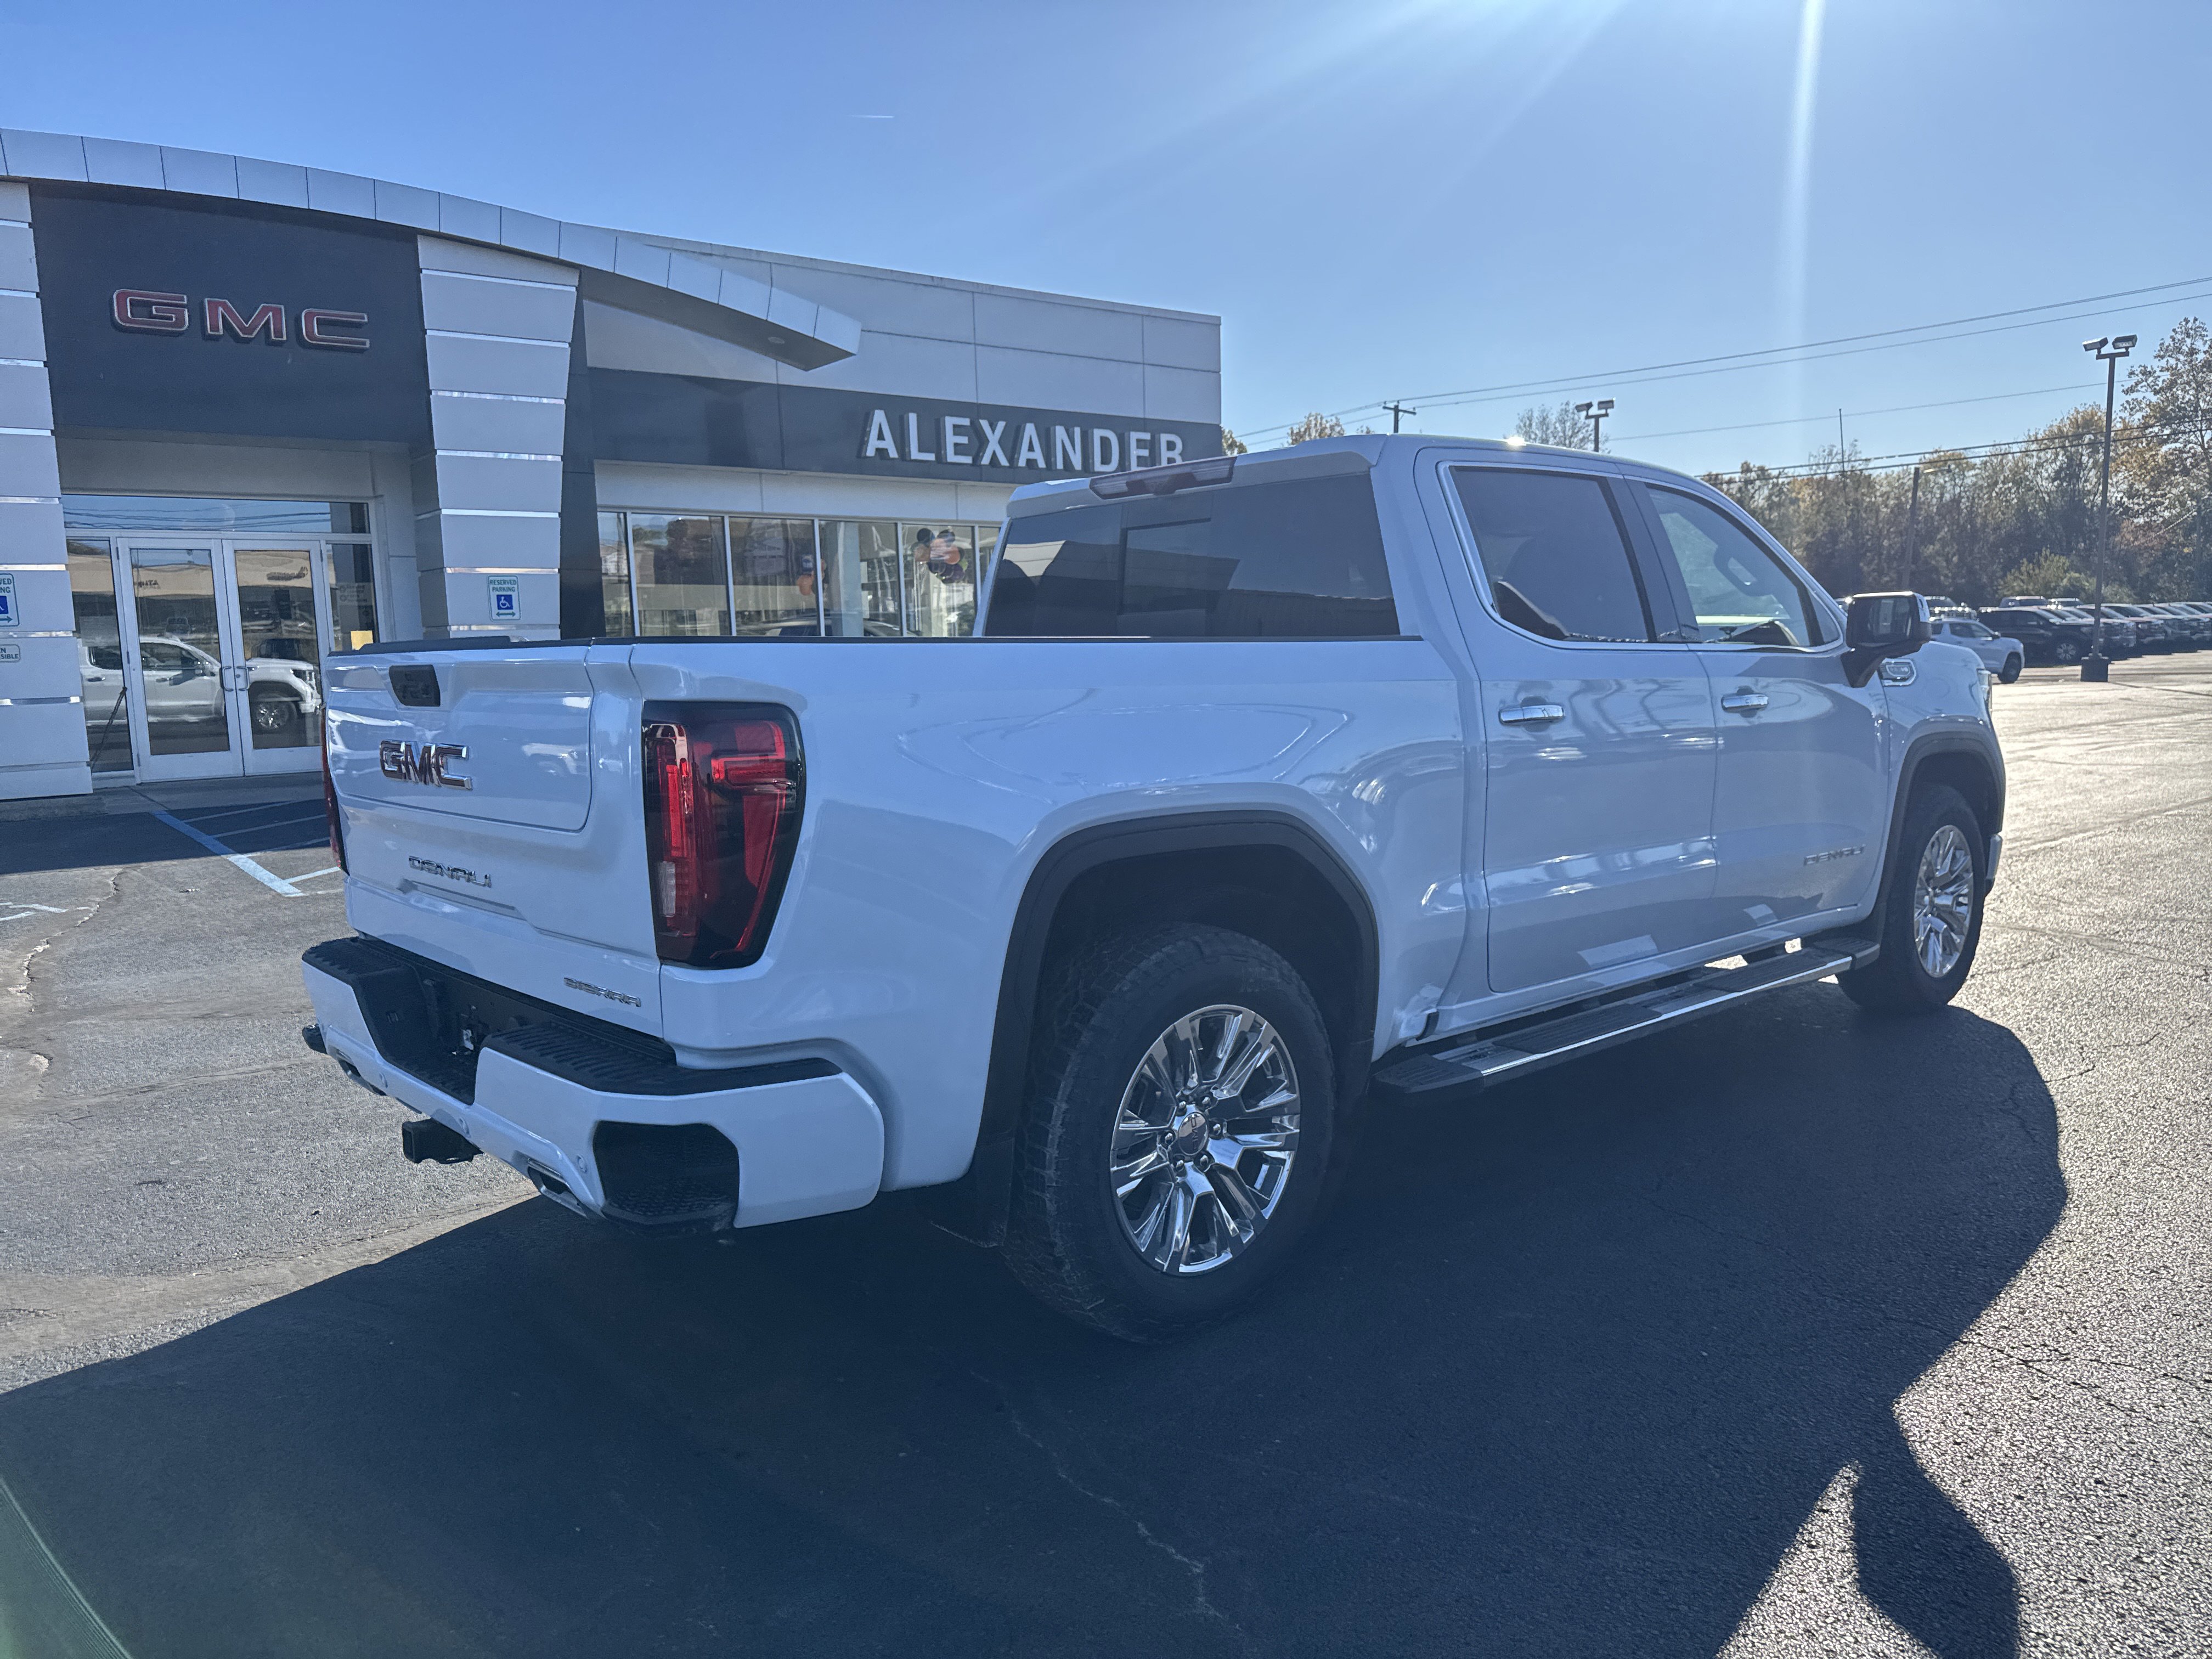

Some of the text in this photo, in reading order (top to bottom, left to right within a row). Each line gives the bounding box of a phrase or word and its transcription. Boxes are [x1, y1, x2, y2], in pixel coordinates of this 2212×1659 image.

[113, 289, 371, 348] GMC
[864, 409, 1184, 473] ALEXANDER
[380, 740, 473, 790] GMC
[409, 856, 492, 888] DENALI
[563, 977, 641, 1008] SIERRA
